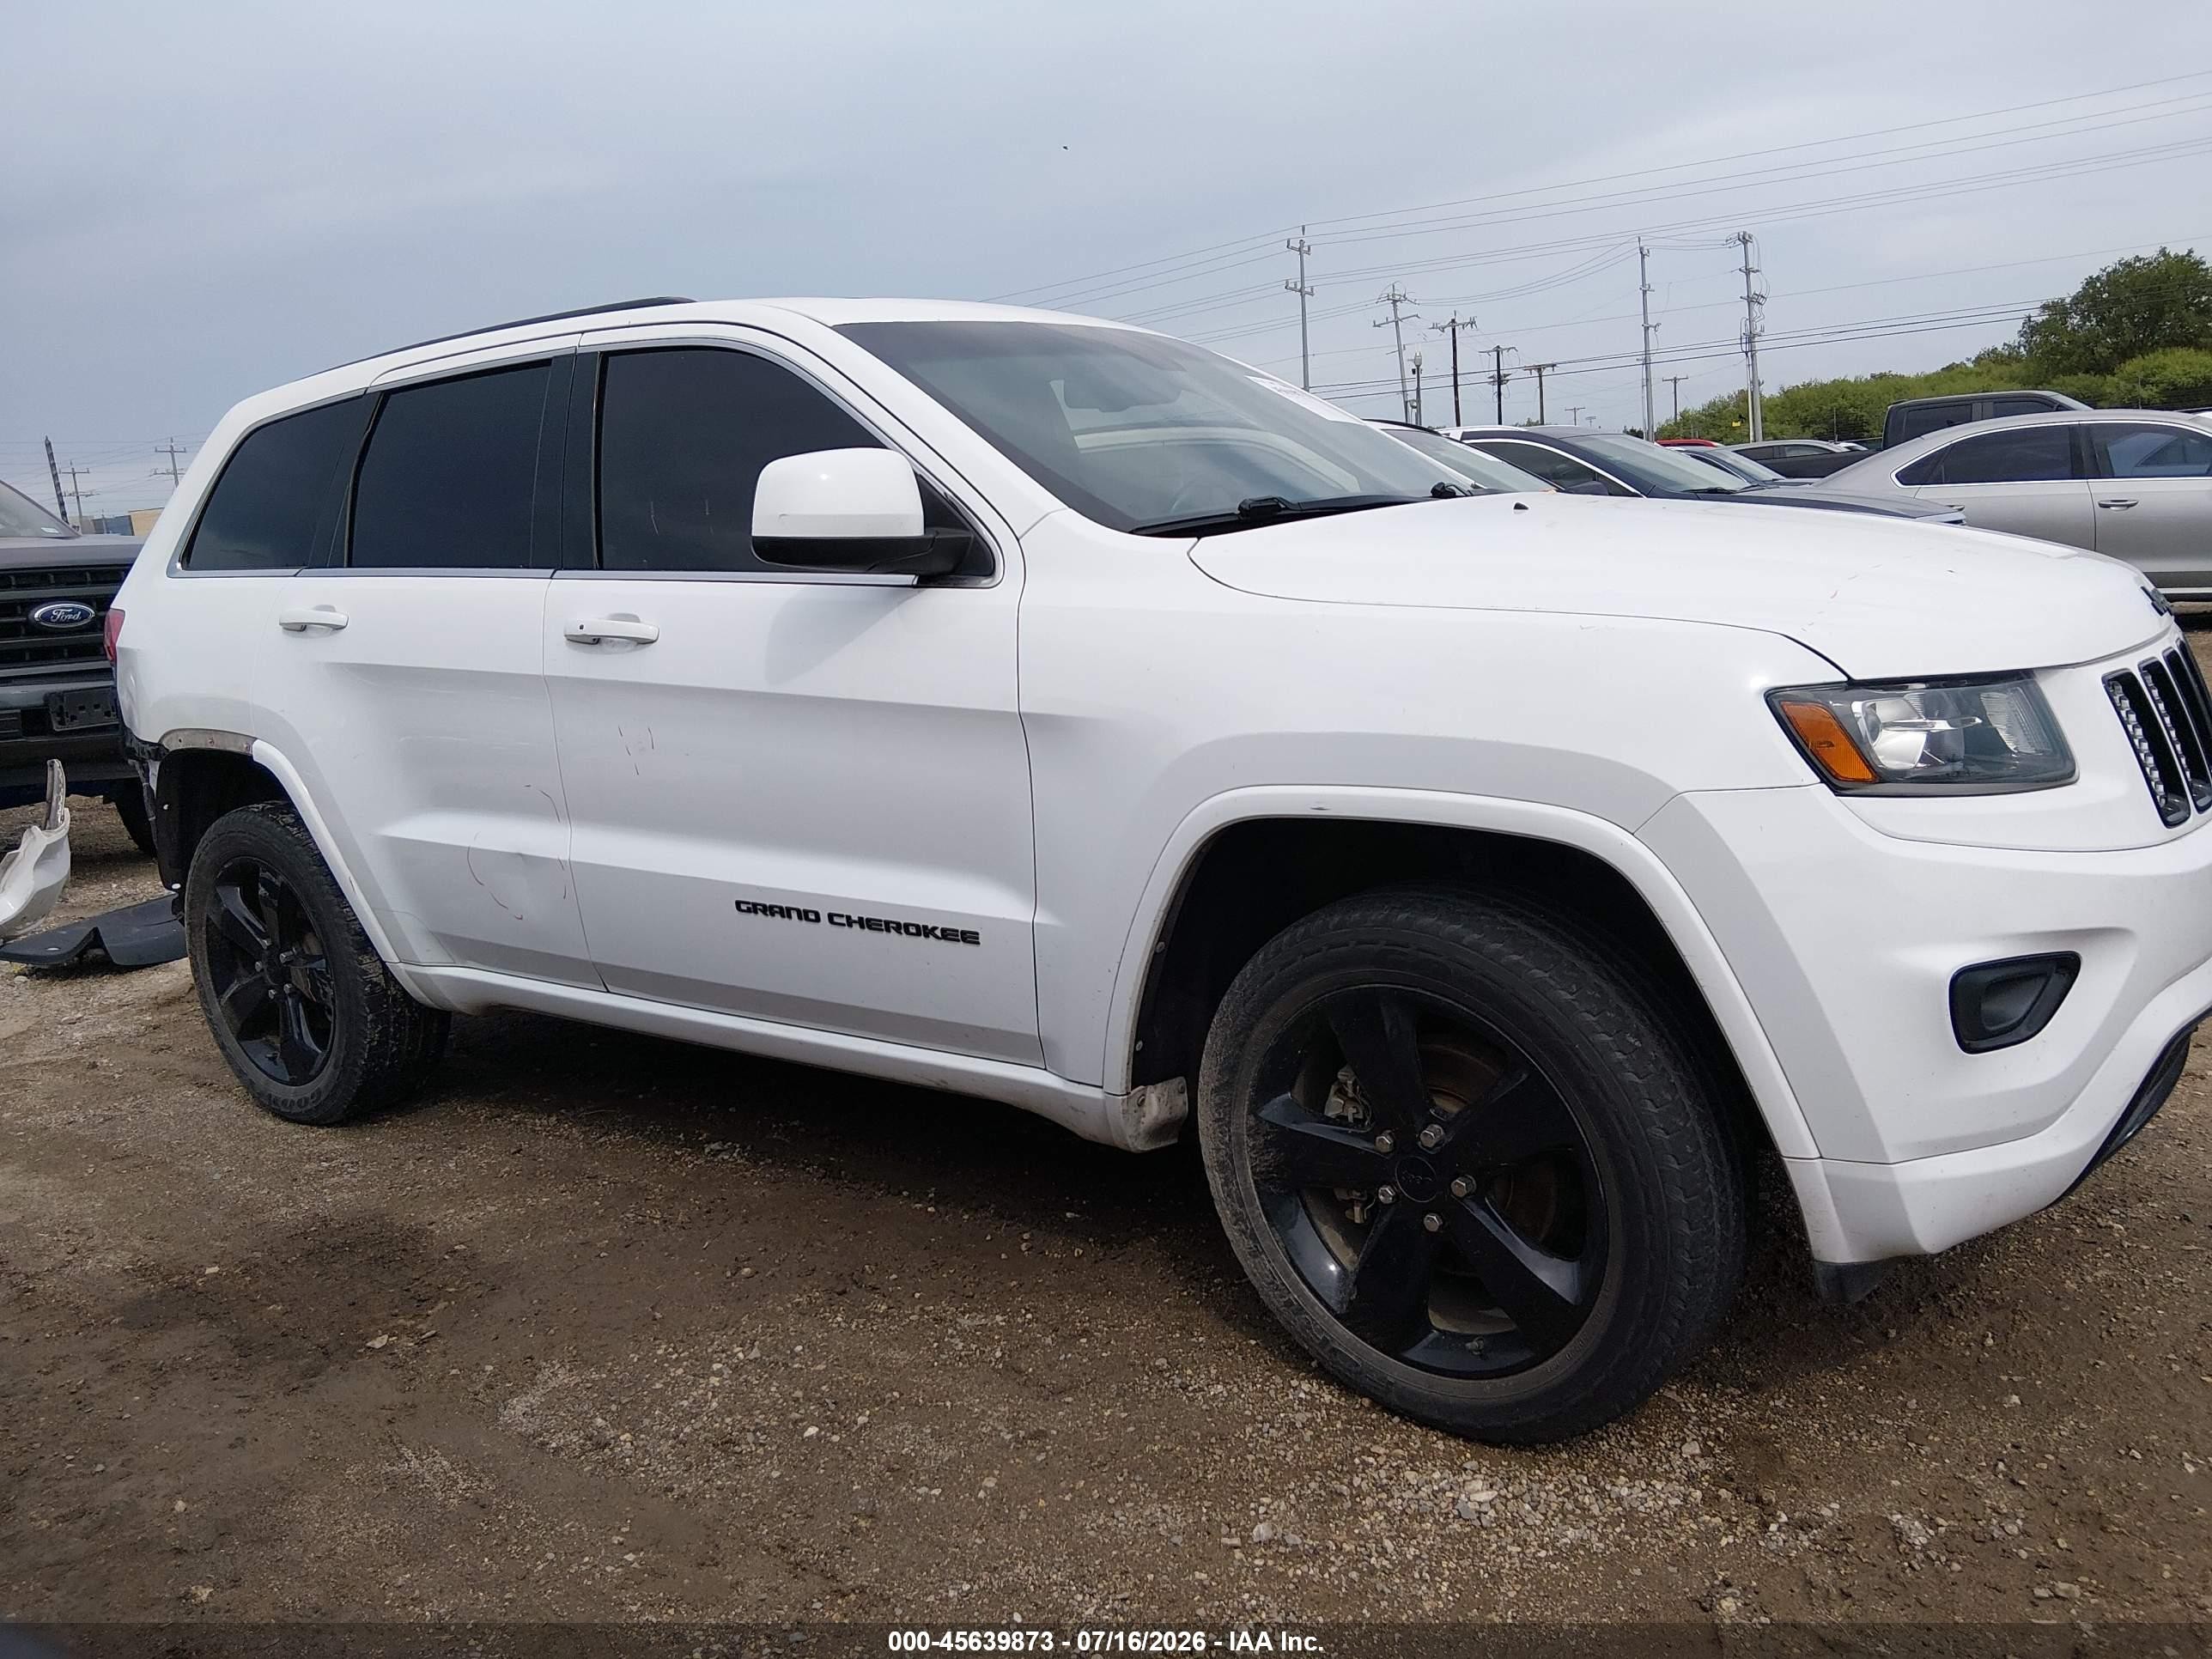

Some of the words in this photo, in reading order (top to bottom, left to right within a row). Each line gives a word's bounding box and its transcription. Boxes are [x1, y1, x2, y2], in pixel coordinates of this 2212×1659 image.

[50, 608, 82, 623] Ford
[733, 899, 822, 924] GRAND
[827, 911, 981, 945] CHEROKEE
